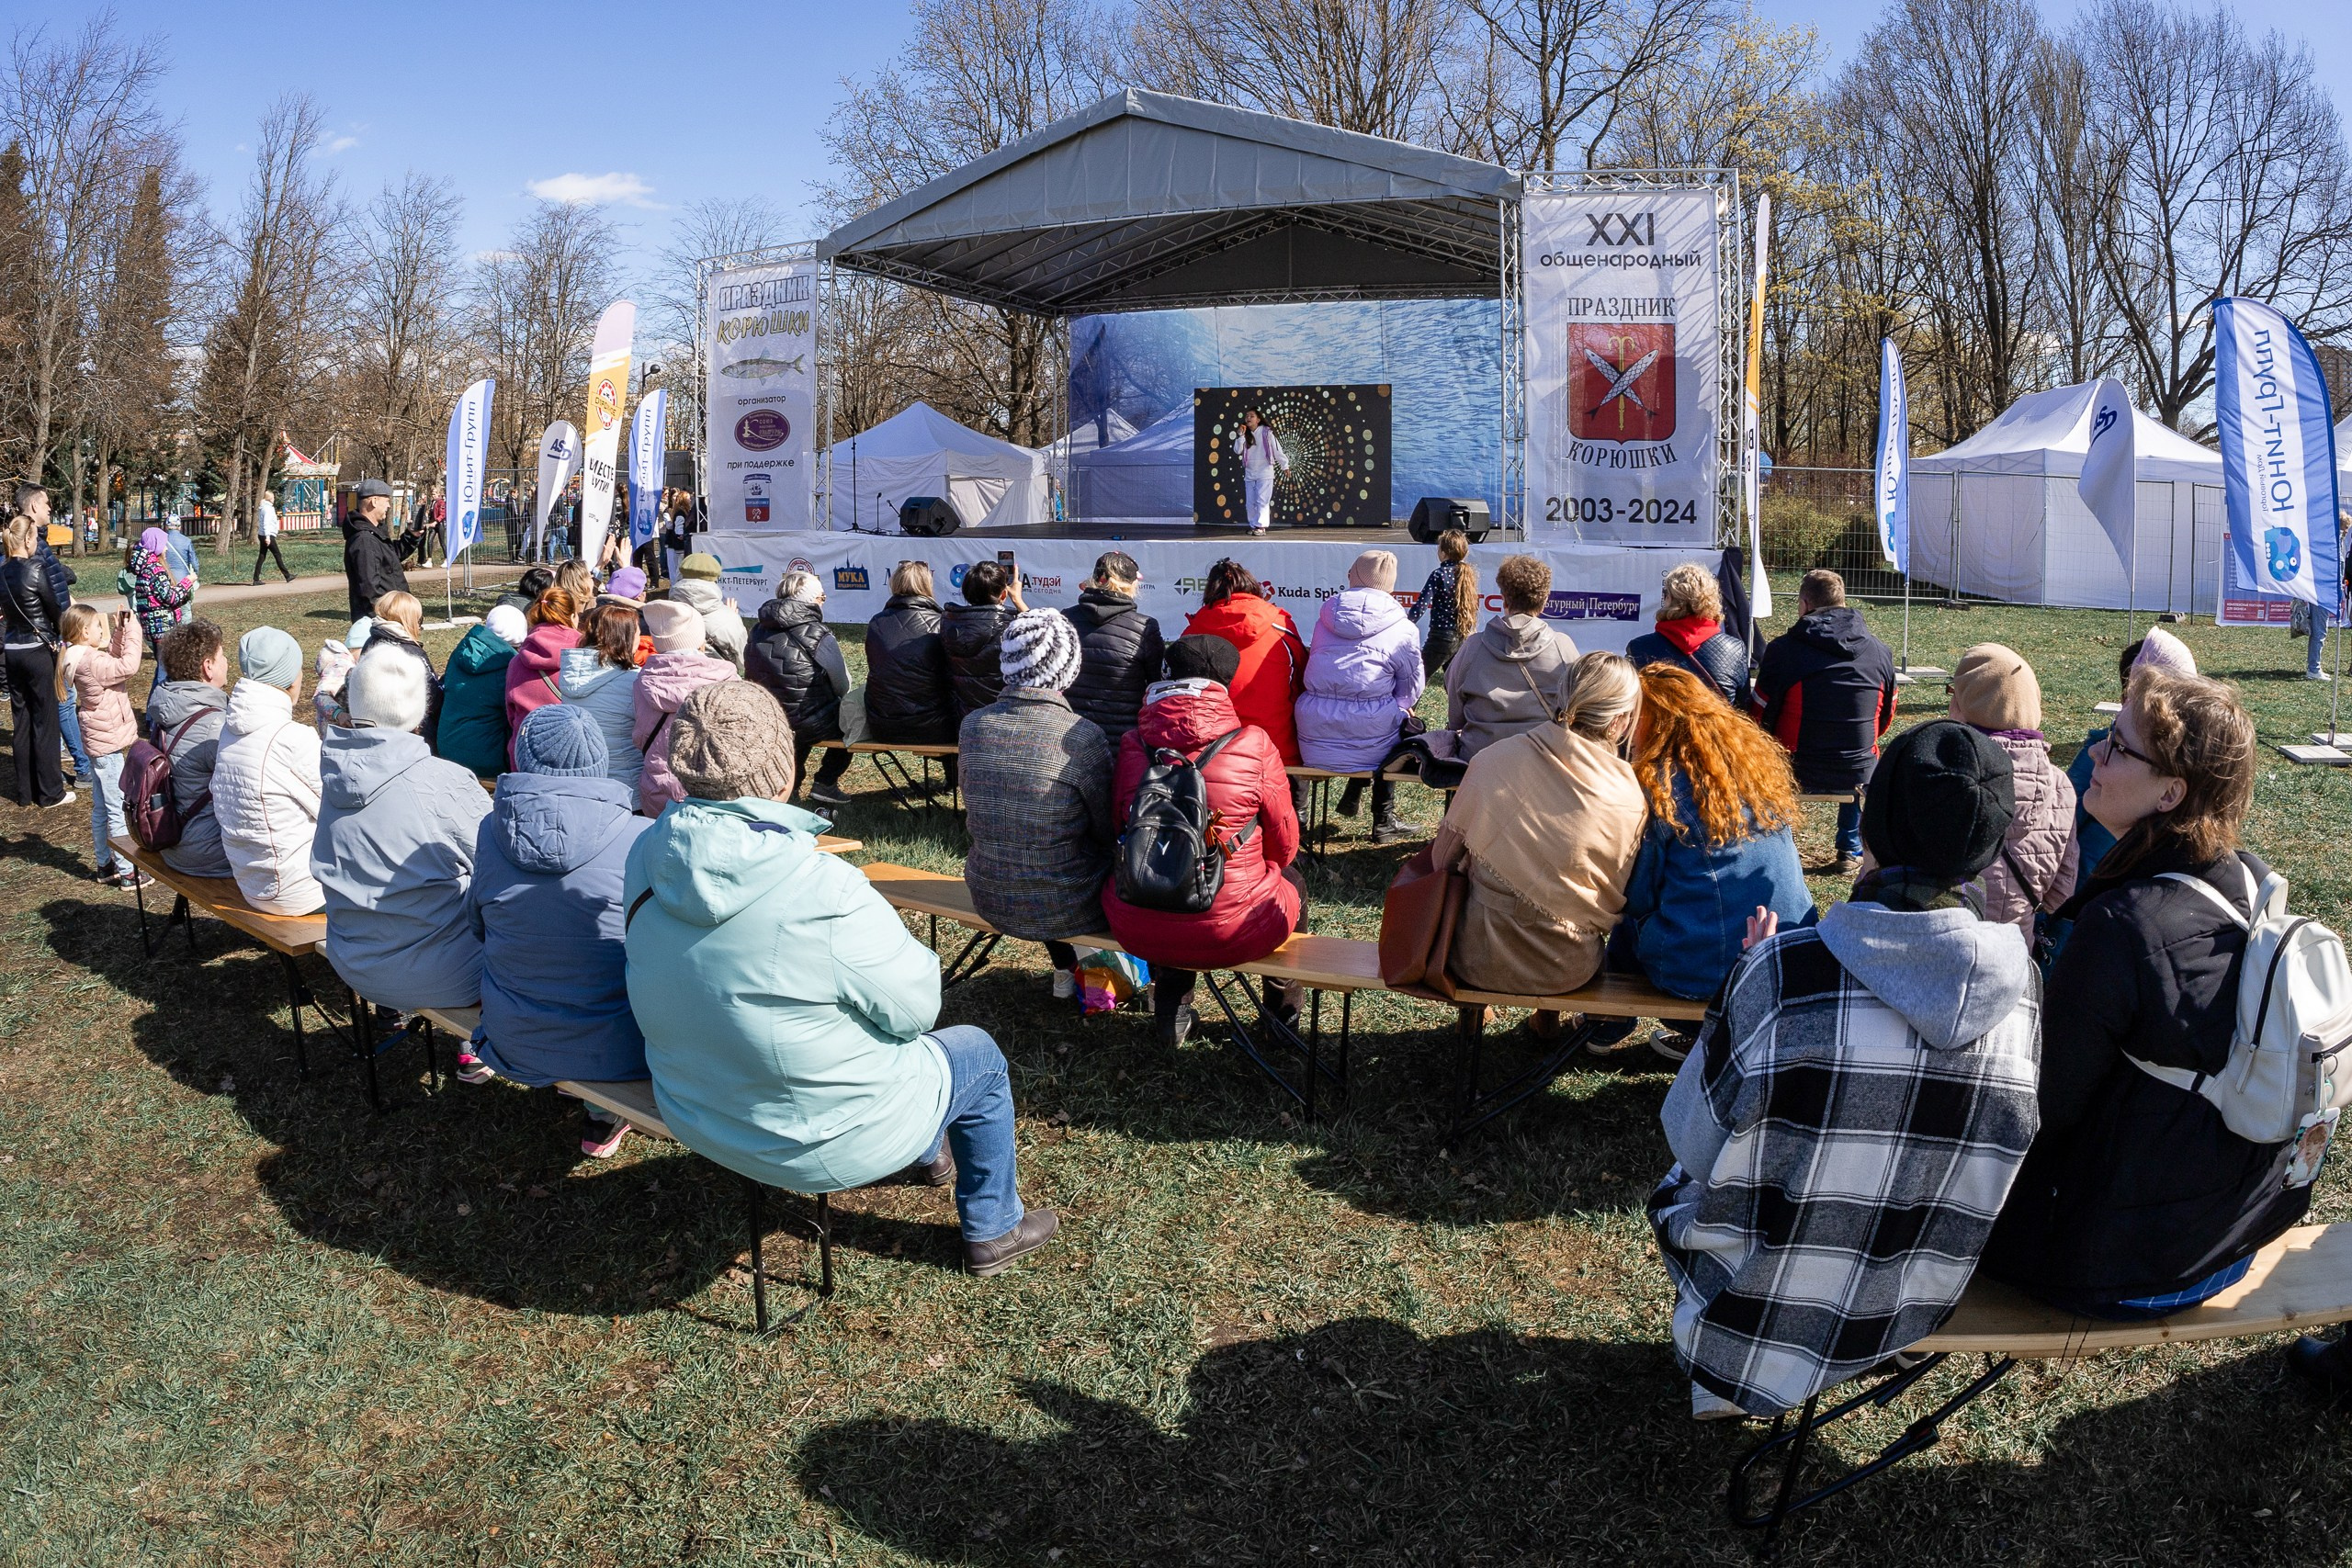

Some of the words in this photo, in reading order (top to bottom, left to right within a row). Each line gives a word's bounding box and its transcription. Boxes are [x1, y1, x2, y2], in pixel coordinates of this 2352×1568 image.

[1586, 213, 1655, 246] XXI
[1540, 252, 1702, 270] общенародный
[719, 276, 809, 312] ПРАЗДНИК
[1566, 297, 1676, 321] ПРАЗДНИК
[716, 310, 810, 345] КОРЮШКИ
[738, 395, 786, 407] организатор
[464, 400, 477, 502] Юнит-Групп
[1566, 441, 1679, 469] КОРЮШКИ
[727, 460, 742, 471] при
[744, 459, 795, 469] поддержке
[1545, 497, 1698, 525] 2003-2024
[716, 576, 768, 586] НКТ-ПЕТЕРБУРГ
[838, 571, 865, 583] МУКА
[1019, 573, 1061, 589] А.ТУДЭЙ
[1278, 587, 1311, 598] Kuda
[1544, 598, 1585, 613] ьтурный
[1589, 597, 1639, 615] Петербург
